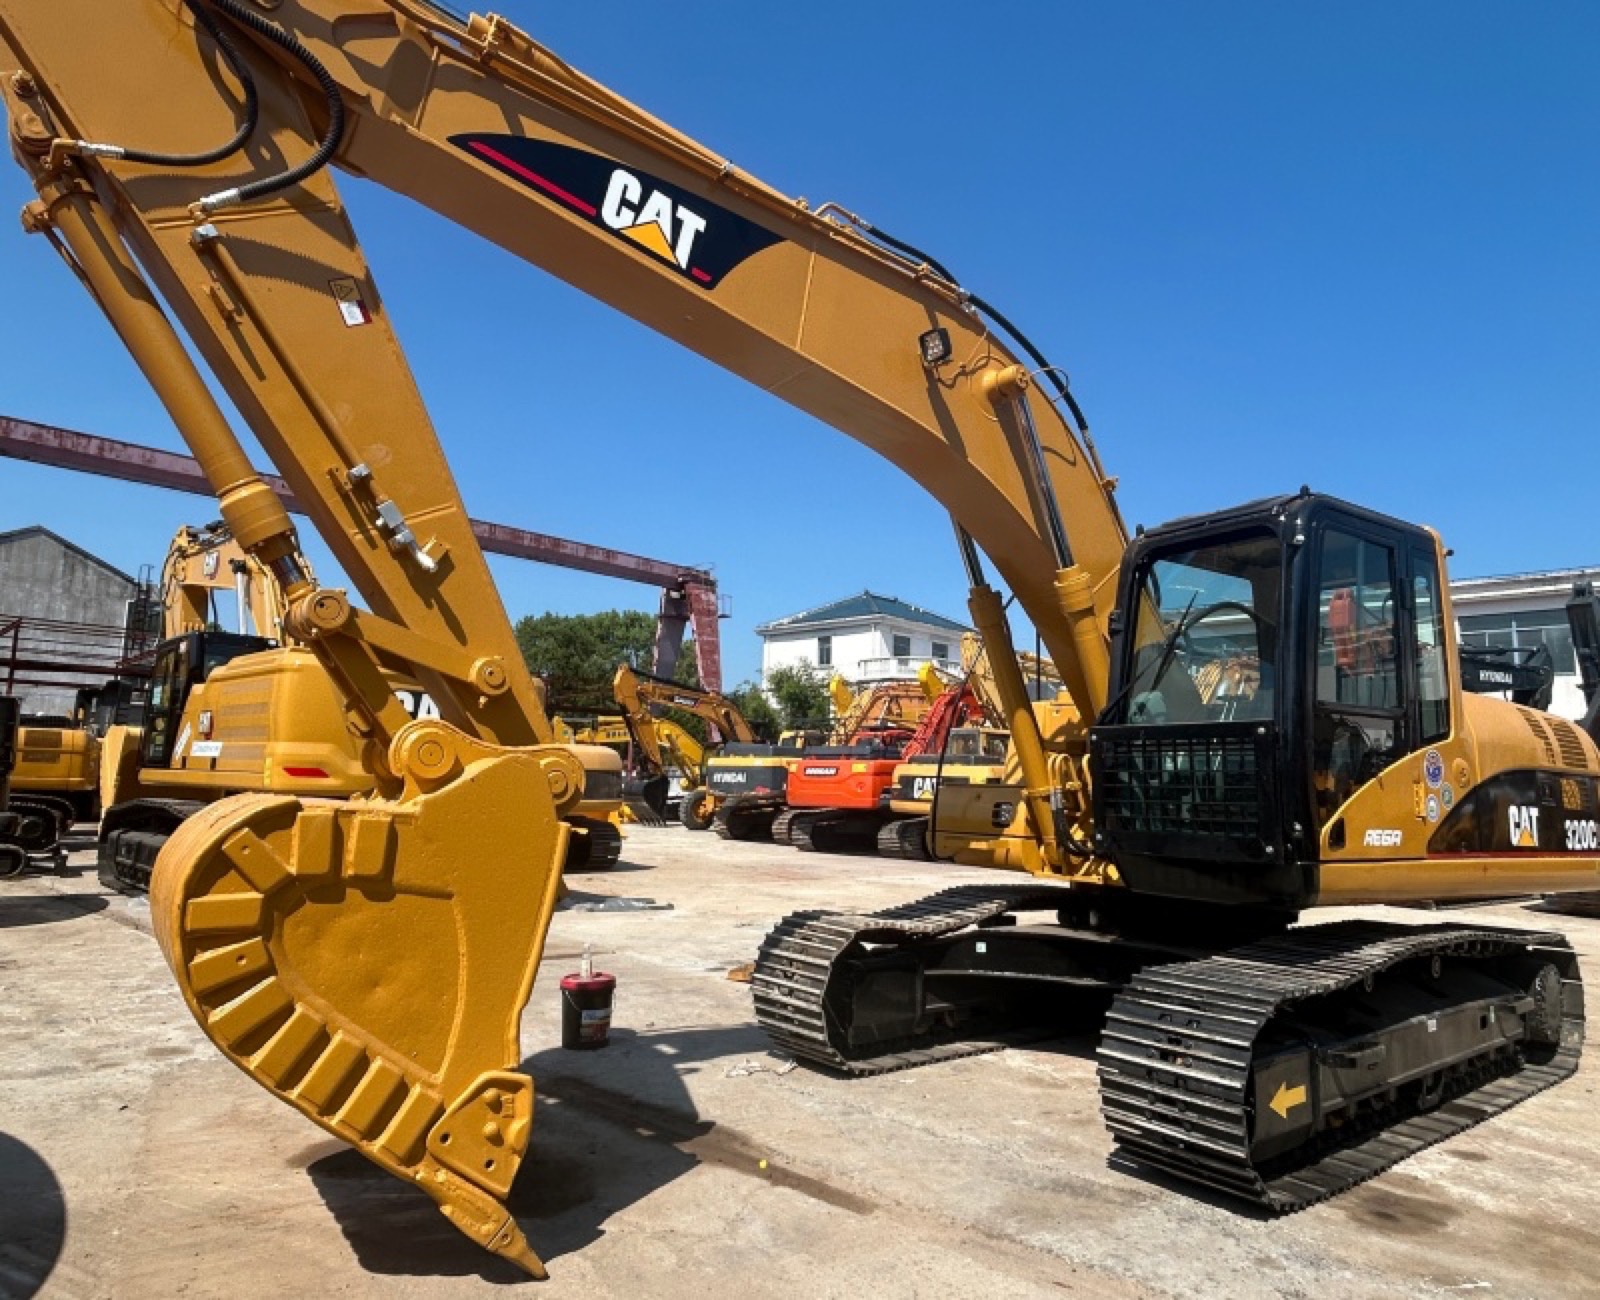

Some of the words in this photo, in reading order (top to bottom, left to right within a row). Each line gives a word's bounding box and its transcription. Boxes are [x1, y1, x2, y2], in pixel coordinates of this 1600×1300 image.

[601, 168, 707, 270] CAT
[1507, 805, 1540, 847] CAT
[1564, 819, 1598, 851] 320C
